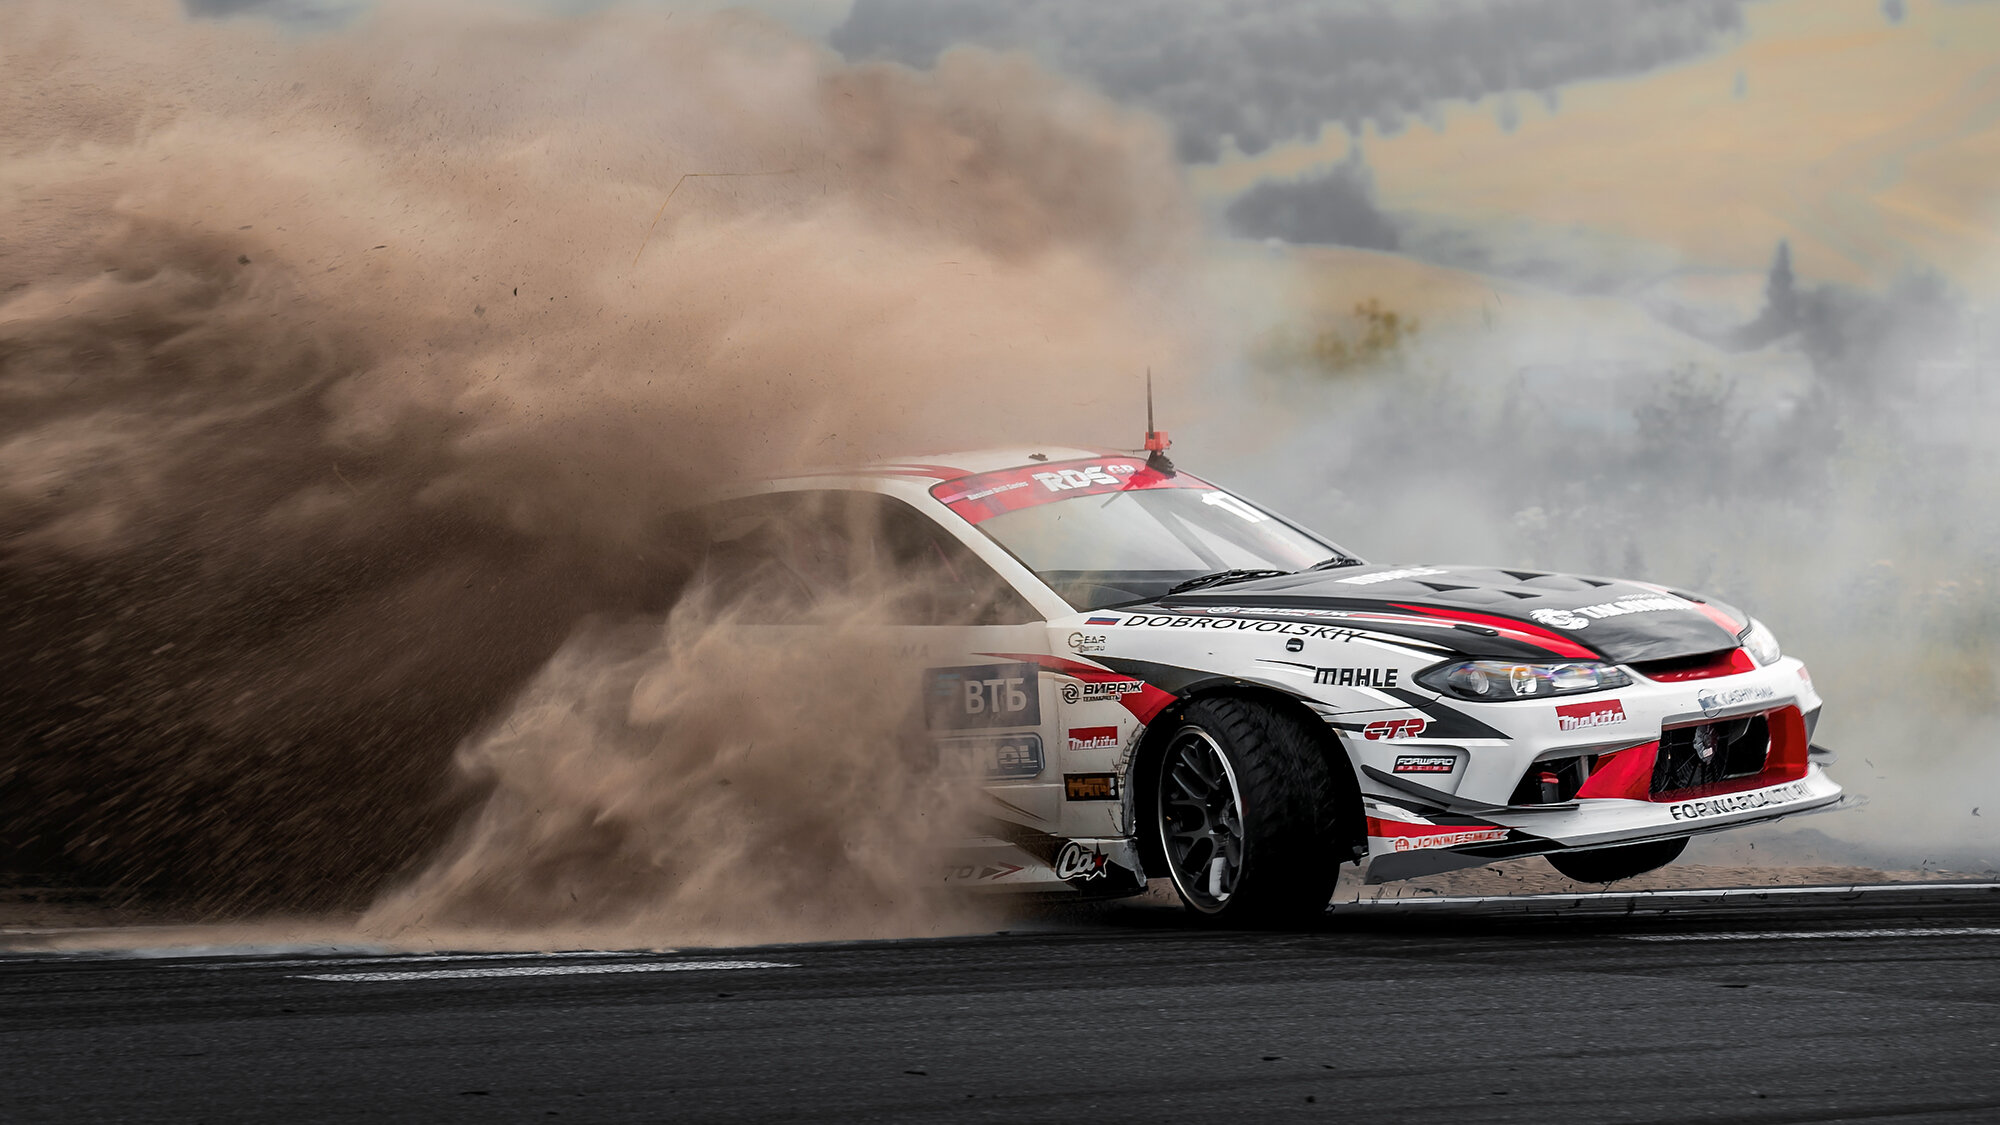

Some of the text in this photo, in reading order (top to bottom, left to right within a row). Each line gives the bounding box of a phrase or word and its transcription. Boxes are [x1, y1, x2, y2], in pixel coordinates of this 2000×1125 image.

[1032, 466, 1120, 492] RDS
[1123, 615, 1365, 643] DOBROVOLSKIY
[1083, 681, 1145, 695] ВИРАЖ
[1313, 668, 1398, 687] MAHLE
[964, 678, 1027, 714] ВТБ
[1397, 757, 1454, 766] FORWARD
